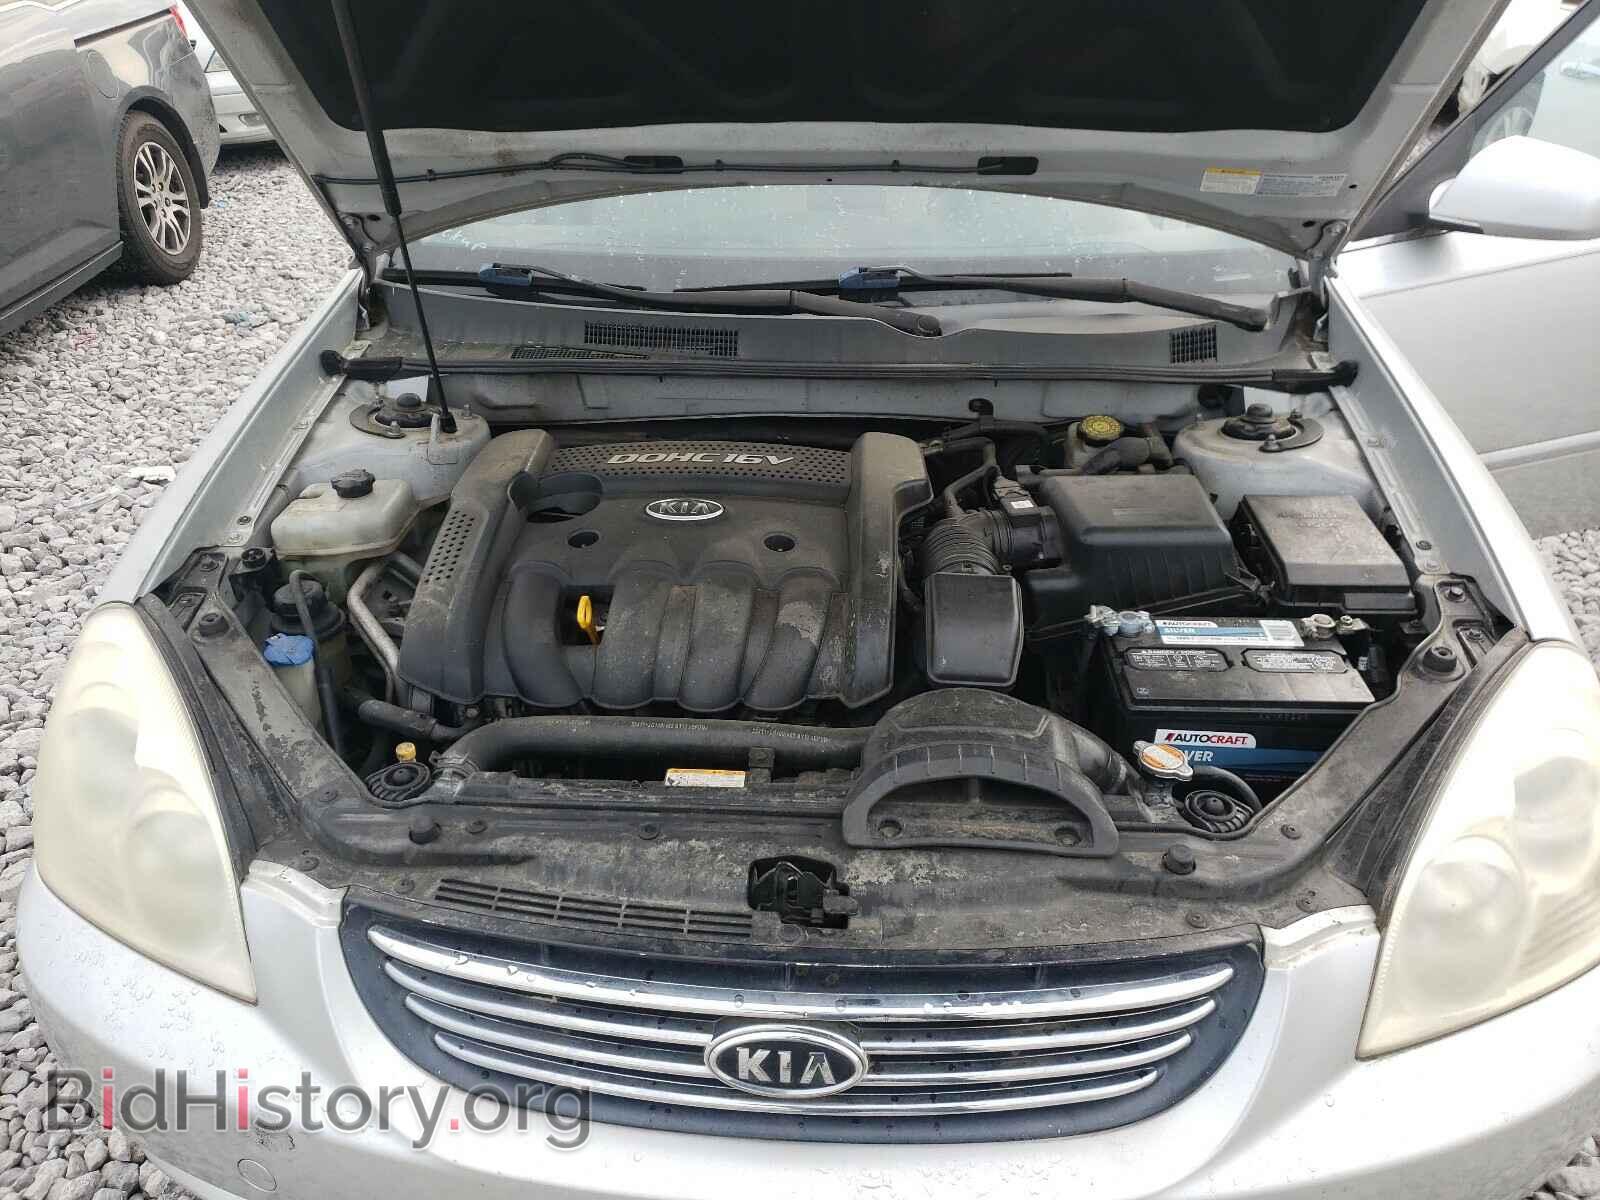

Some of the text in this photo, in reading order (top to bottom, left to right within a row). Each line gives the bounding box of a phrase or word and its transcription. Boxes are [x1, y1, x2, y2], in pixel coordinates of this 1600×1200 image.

[607, 452, 795, 465] DOHC 16V
[658, 501, 711, 515] KIA
[1173, 732, 1249, 745] AUTOCRAFT
[1184, 750, 1214, 762] VER
[736, 1046, 836, 1085] KIA
